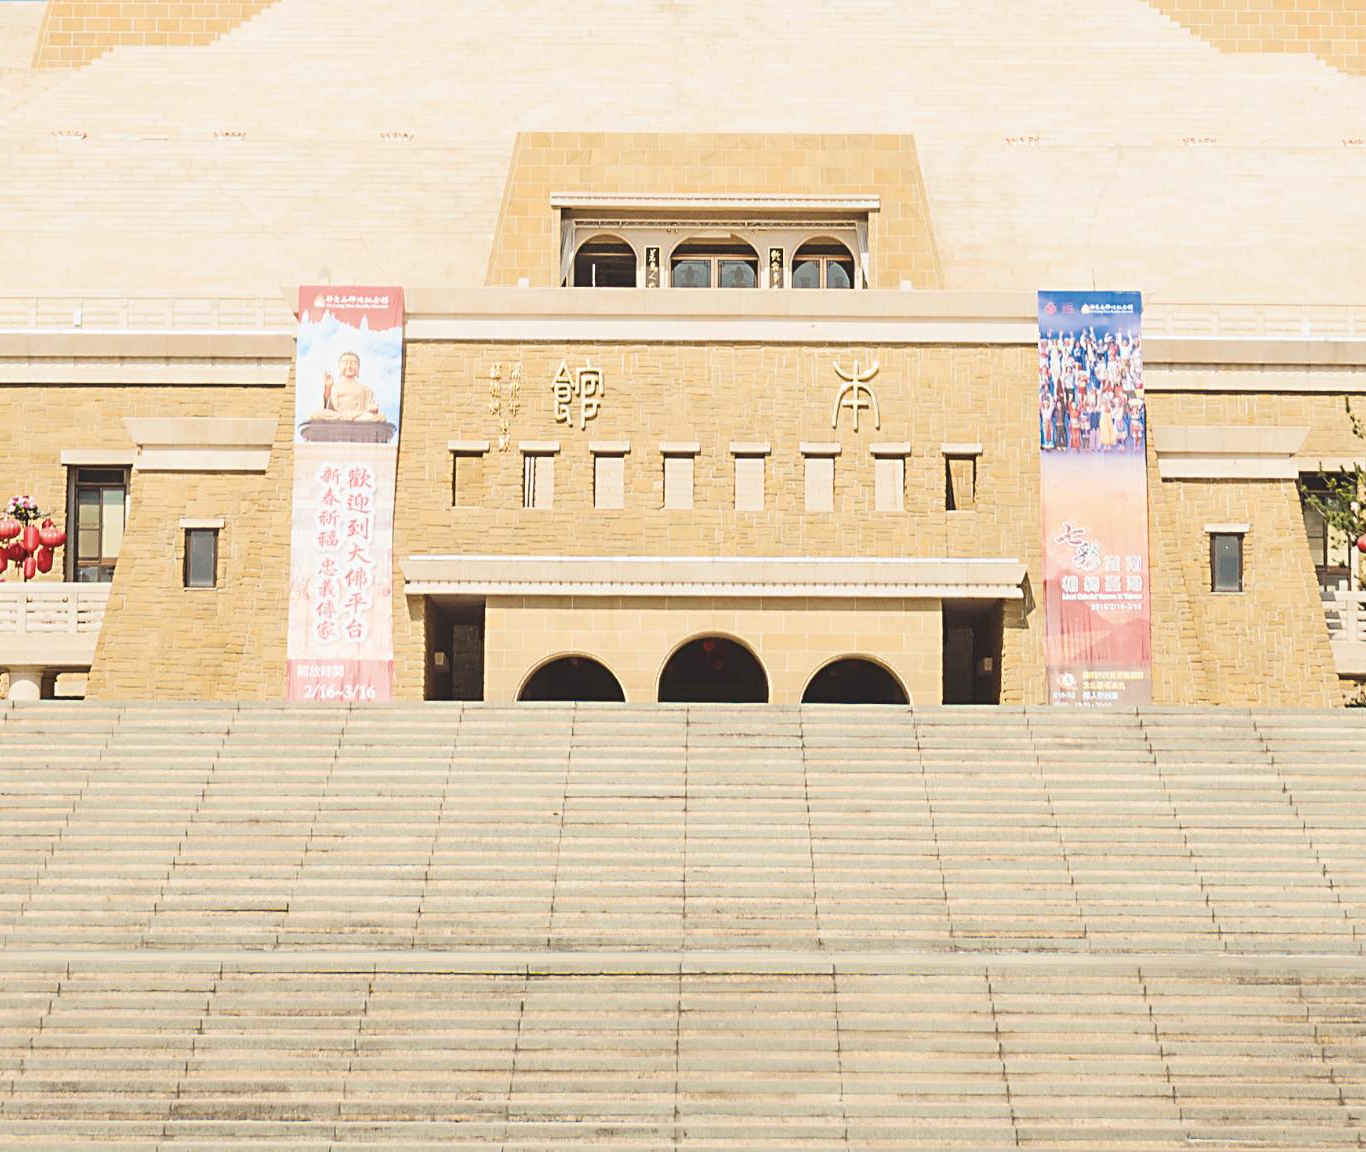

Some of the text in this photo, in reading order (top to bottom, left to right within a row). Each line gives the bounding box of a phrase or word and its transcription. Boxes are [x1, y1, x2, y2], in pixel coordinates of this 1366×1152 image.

[550, 358, 604, 431] 館
[317, 466, 341, 547] 新春祈福
[345, 467, 372, 639] 歡迎到大佛平台
